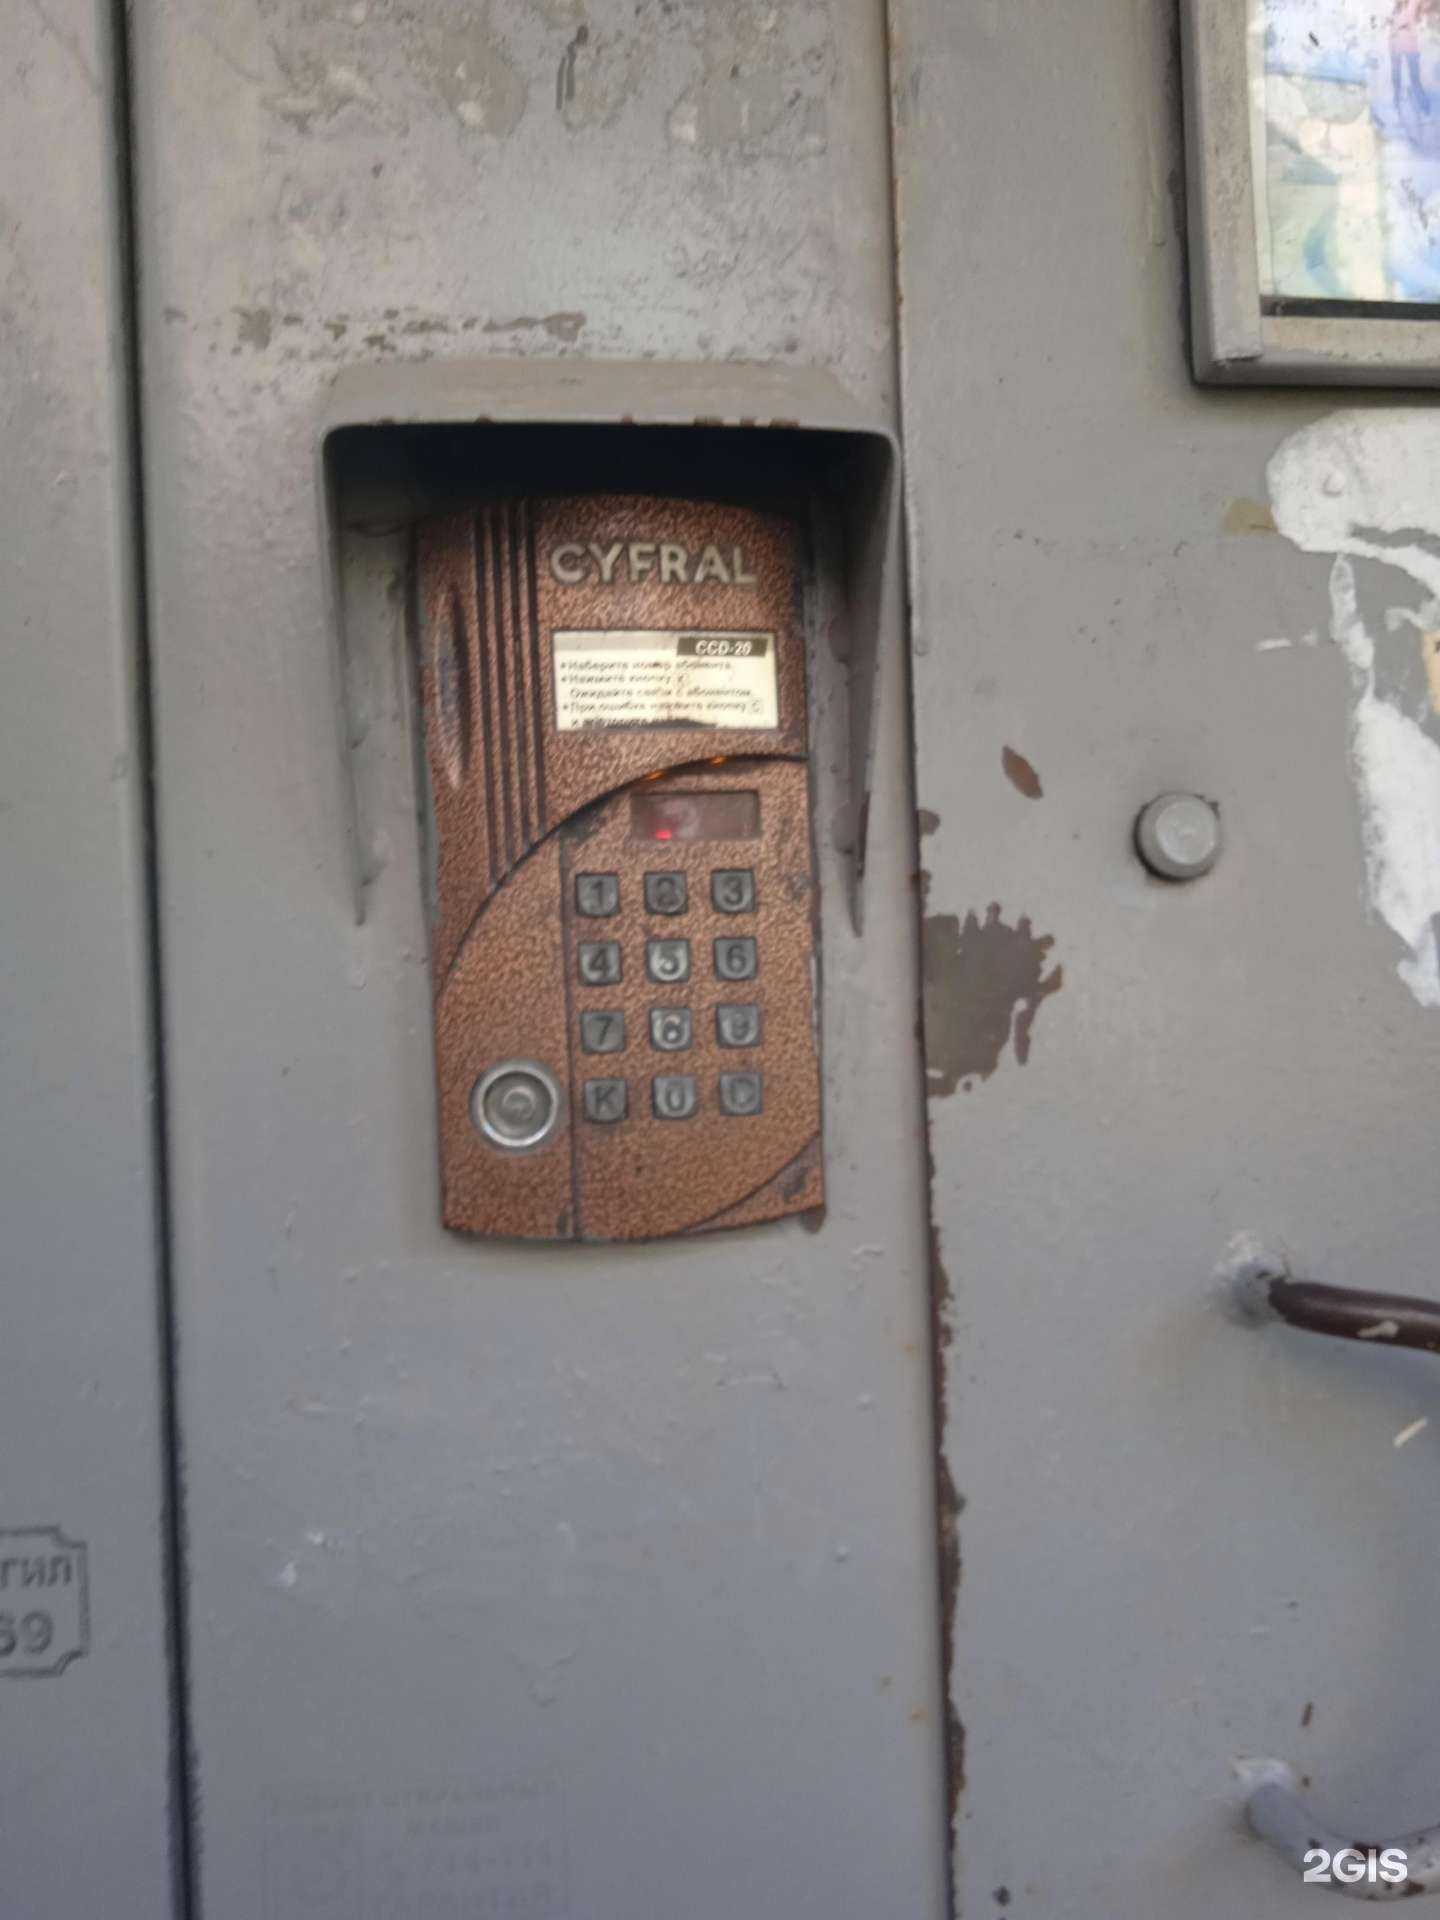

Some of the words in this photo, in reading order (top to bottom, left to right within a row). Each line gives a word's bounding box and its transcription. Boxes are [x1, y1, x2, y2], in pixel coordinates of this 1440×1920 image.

[550, 541, 758, 585] CYFRAL
[656, 877, 675, 906] 2
[724, 877, 743, 906] 3
[588, 949, 609, 978] 4
[659, 946, 680, 976] 5
[725, 945, 745, 972] 6
[592, 1016, 615, 1045] 7
